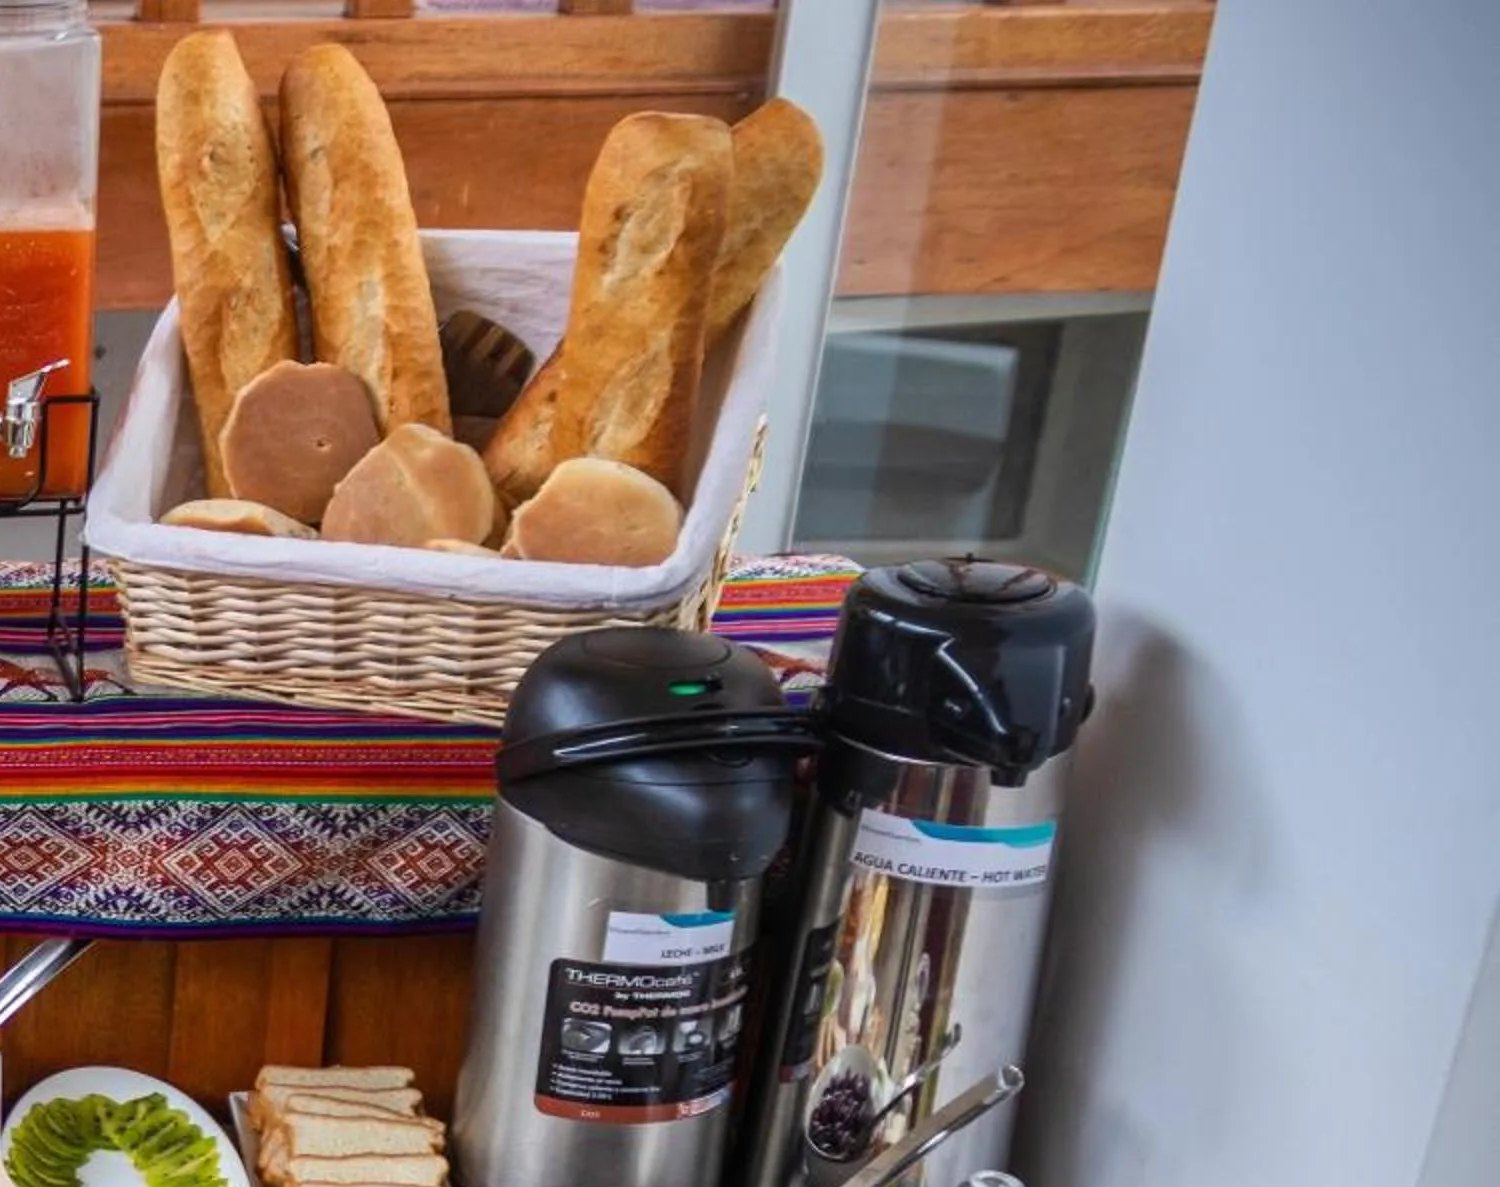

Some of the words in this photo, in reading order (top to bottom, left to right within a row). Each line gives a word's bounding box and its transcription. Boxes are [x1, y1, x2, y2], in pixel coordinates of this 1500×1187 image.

[854, 852, 893, 871] AGUA
[897, 863, 967, 882] CALIENTE
[982, 869, 1011, 883] HOT
